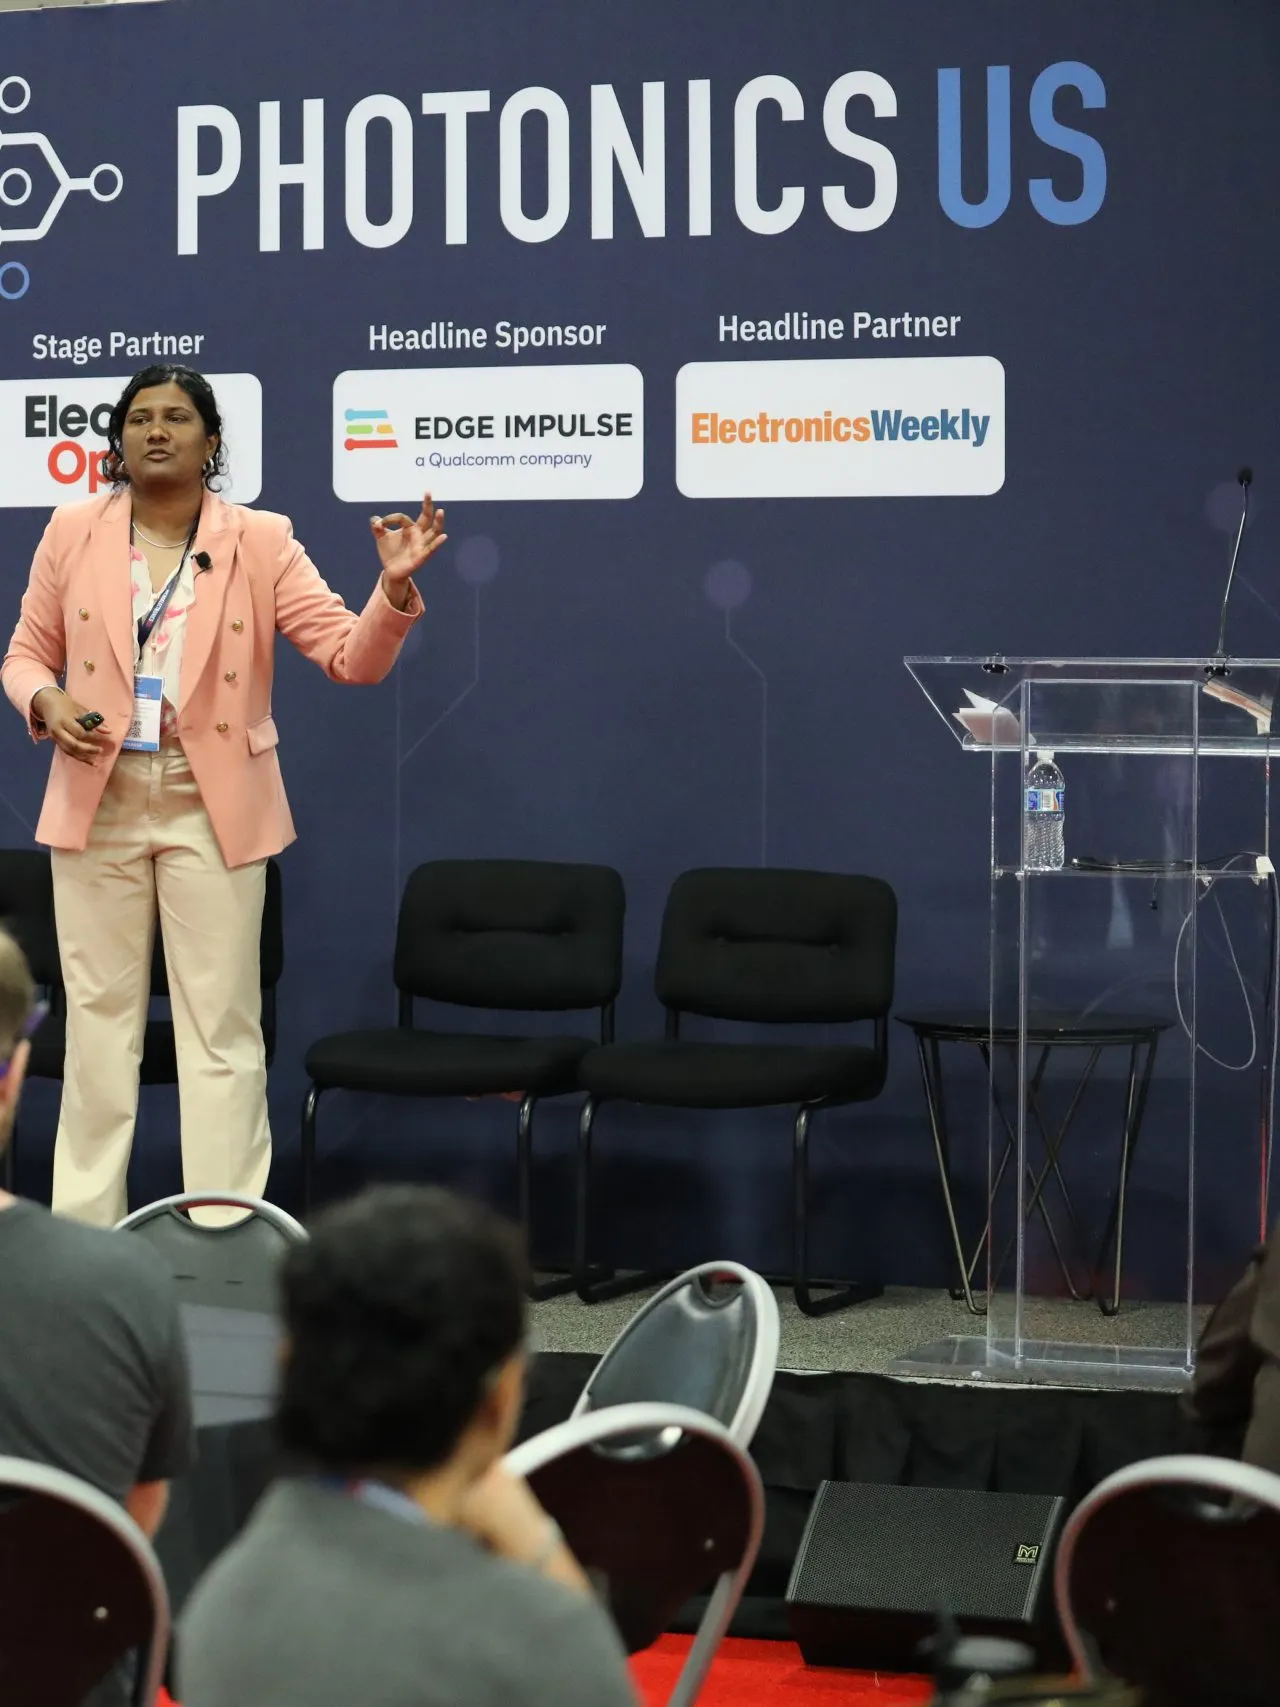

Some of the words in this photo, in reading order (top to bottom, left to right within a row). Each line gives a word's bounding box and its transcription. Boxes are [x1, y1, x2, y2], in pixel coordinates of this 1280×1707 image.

[177, 70, 899, 255] PHOTONICS
[937, 61, 1108, 229] US
[369, 321, 488, 351] Headline
[494, 320, 607, 354] Sponsor
[719, 311, 845, 342] Headline
[852, 310, 962, 340] Partner
[32, 333, 103, 365] Stage
[109, 331, 205, 357] Partner
[25, 394, 111, 438] Elec
[414, 415, 495, 440] EDGE
[504, 412, 633, 438] IMPULSE
[691, 408, 991, 447] ElectronicsWeekly
[47, 440, 114, 494] Op
[415, 456, 425, 467] a
[429, 452, 515, 468] Qualcomm
[519, 453, 592, 468] company
